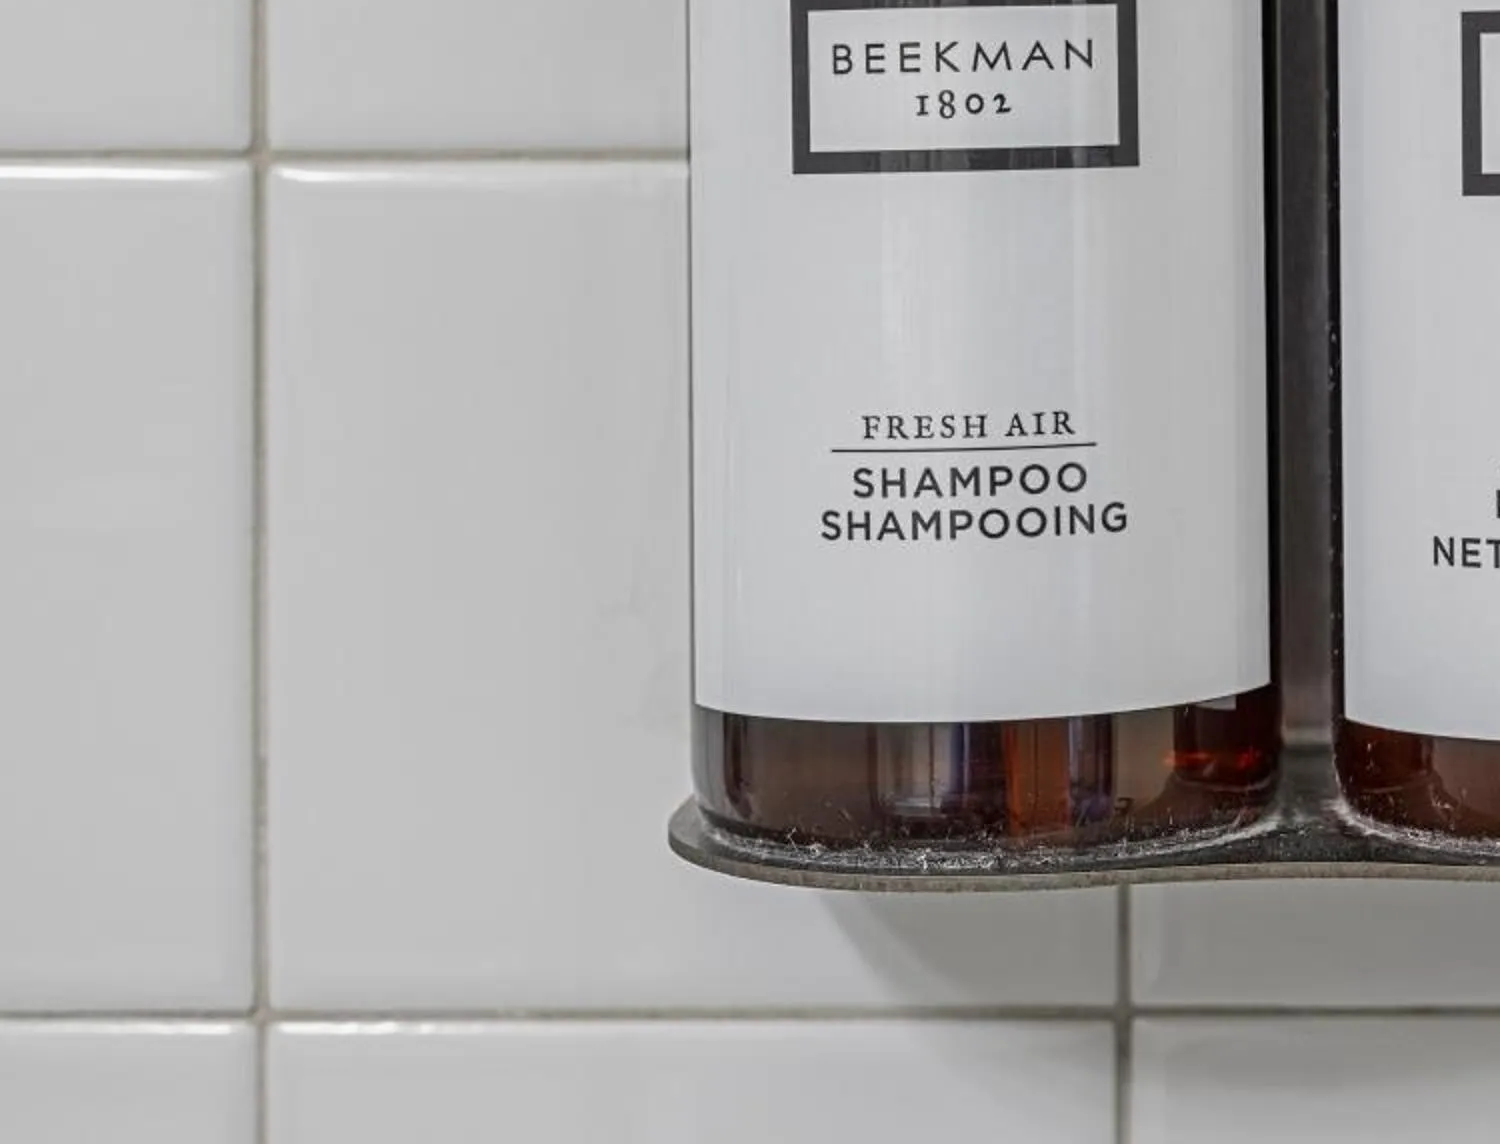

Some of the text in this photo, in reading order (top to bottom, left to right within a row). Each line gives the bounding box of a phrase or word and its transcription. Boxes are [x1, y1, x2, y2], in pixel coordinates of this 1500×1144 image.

[831, 38, 1093, 76] BEEKMAN
[915, 89, 1013, 120] 1802
[861, 409, 1076, 441] FRESH AIR
[852, 461, 1088, 499] SHAMPOO
[820, 501, 1128, 542] SHAMPOOING
